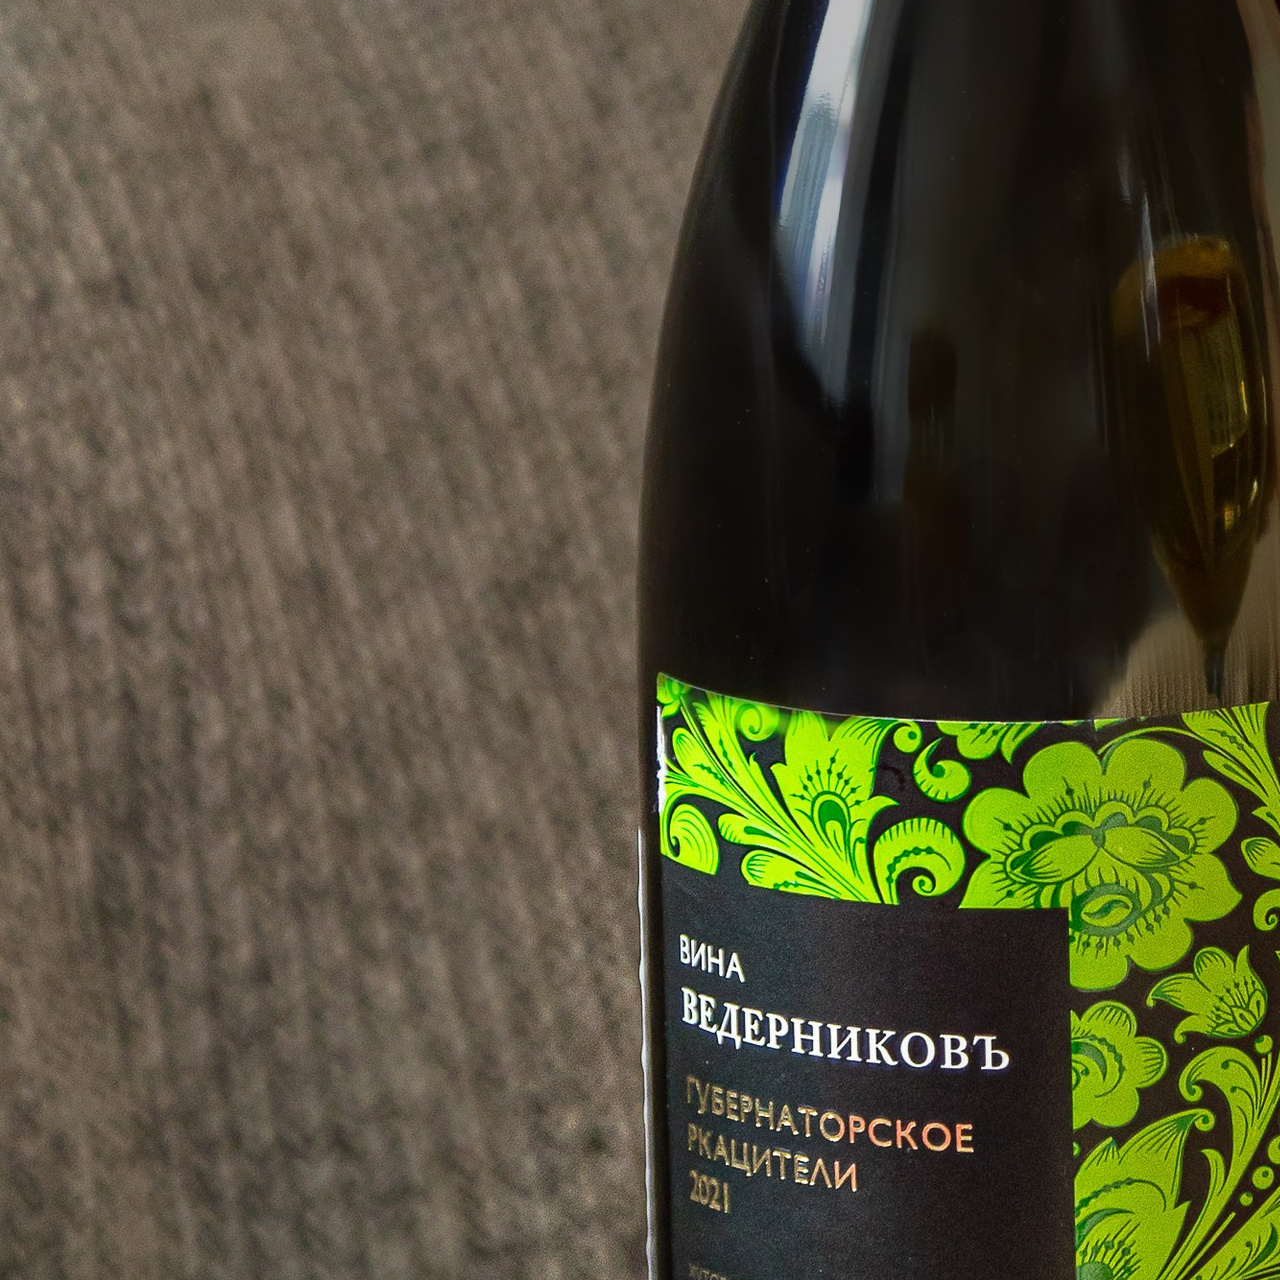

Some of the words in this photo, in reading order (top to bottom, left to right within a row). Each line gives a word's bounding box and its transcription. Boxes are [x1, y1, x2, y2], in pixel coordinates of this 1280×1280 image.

[679, 934, 745, 983] ВИНА
[681, 986, 1010, 1070] ВЕДЕРНИКОВЪ
[686, 1074, 975, 1154] ГУБЕРНАТОРСКОЕ
[688, 1122, 858, 1193] РКАЦИТЕЛИ
[689, 1169, 730, 1214] 2021
